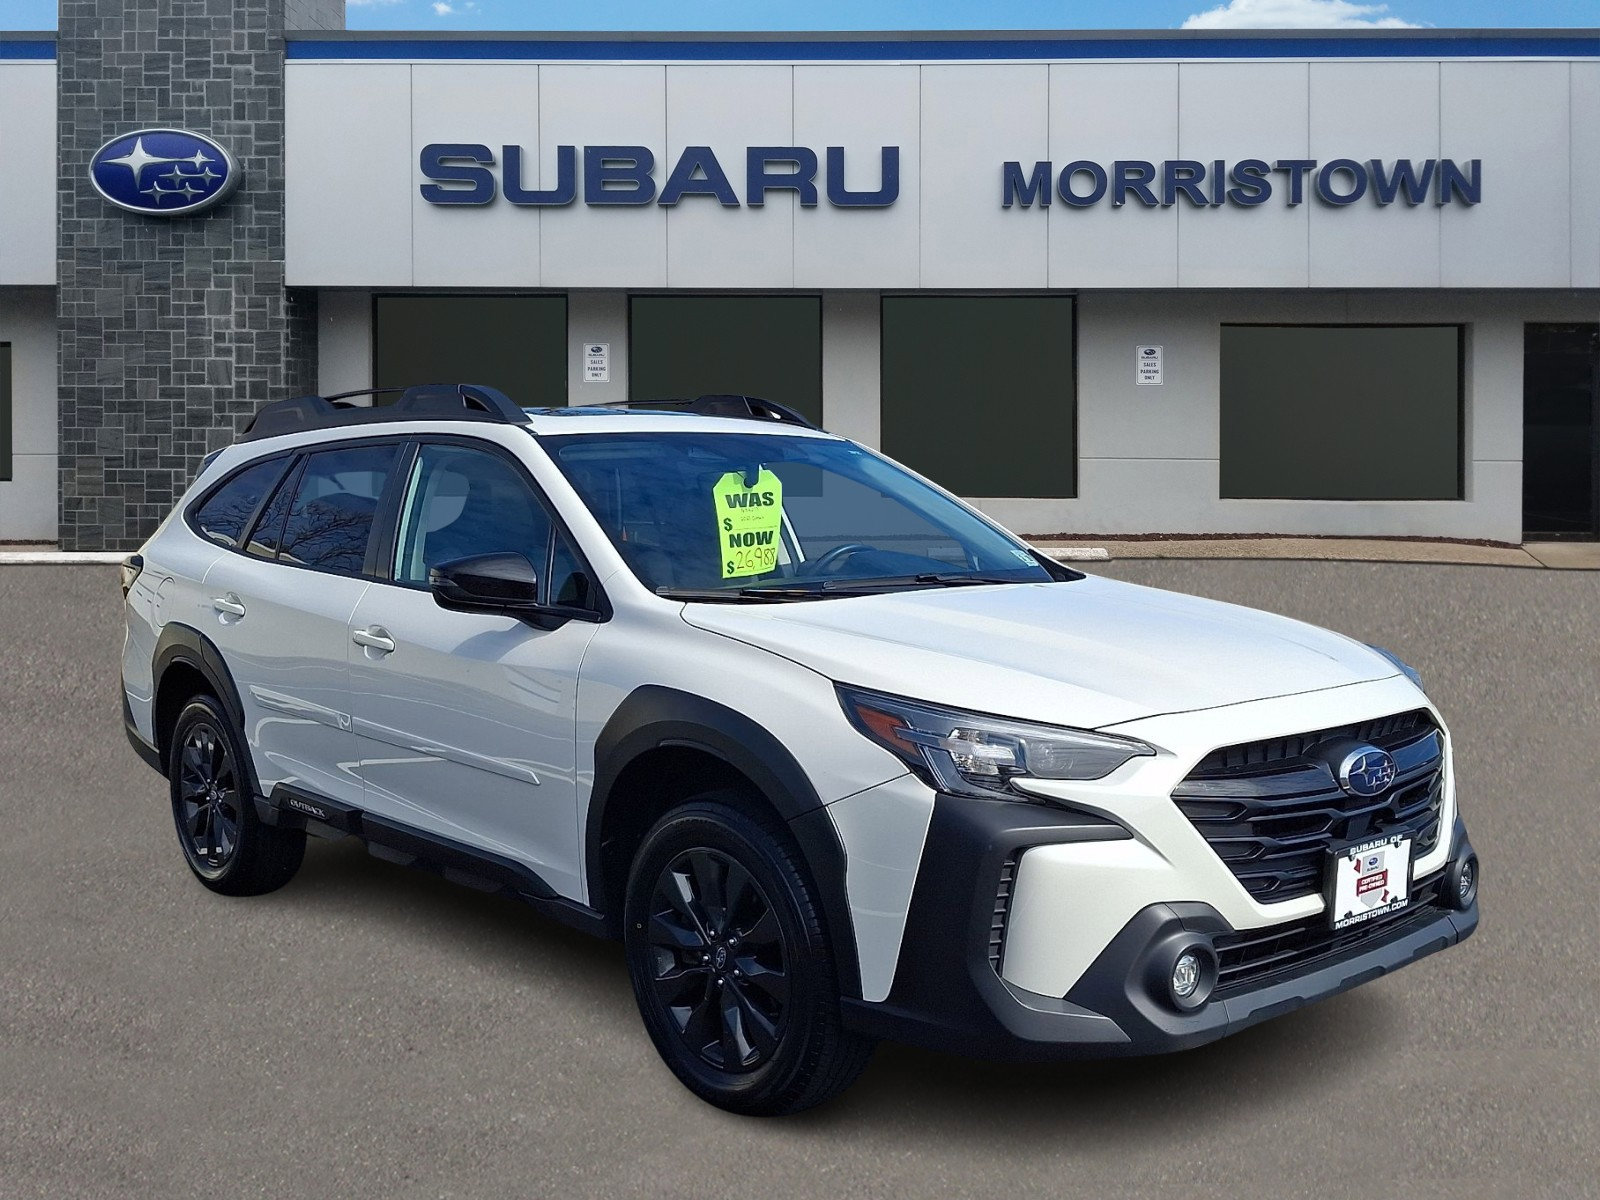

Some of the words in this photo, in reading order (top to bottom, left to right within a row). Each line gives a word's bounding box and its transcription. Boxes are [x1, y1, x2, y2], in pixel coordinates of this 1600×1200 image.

[420, 144, 900, 206] SUBARU
[1002, 158, 1482, 208] MORRISTOWN
[725, 491, 774, 509] WAS
[723, 517, 733, 532] $
[729, 530, 774, 548] NOW
[290, 799, 325, 818] OUTBACK
[1349, 838, 1387, 855] SUBARU
[1390, 834, 1403, 843] OF
[1335, 898, 1408, 930] MORRISTOWN.COM
